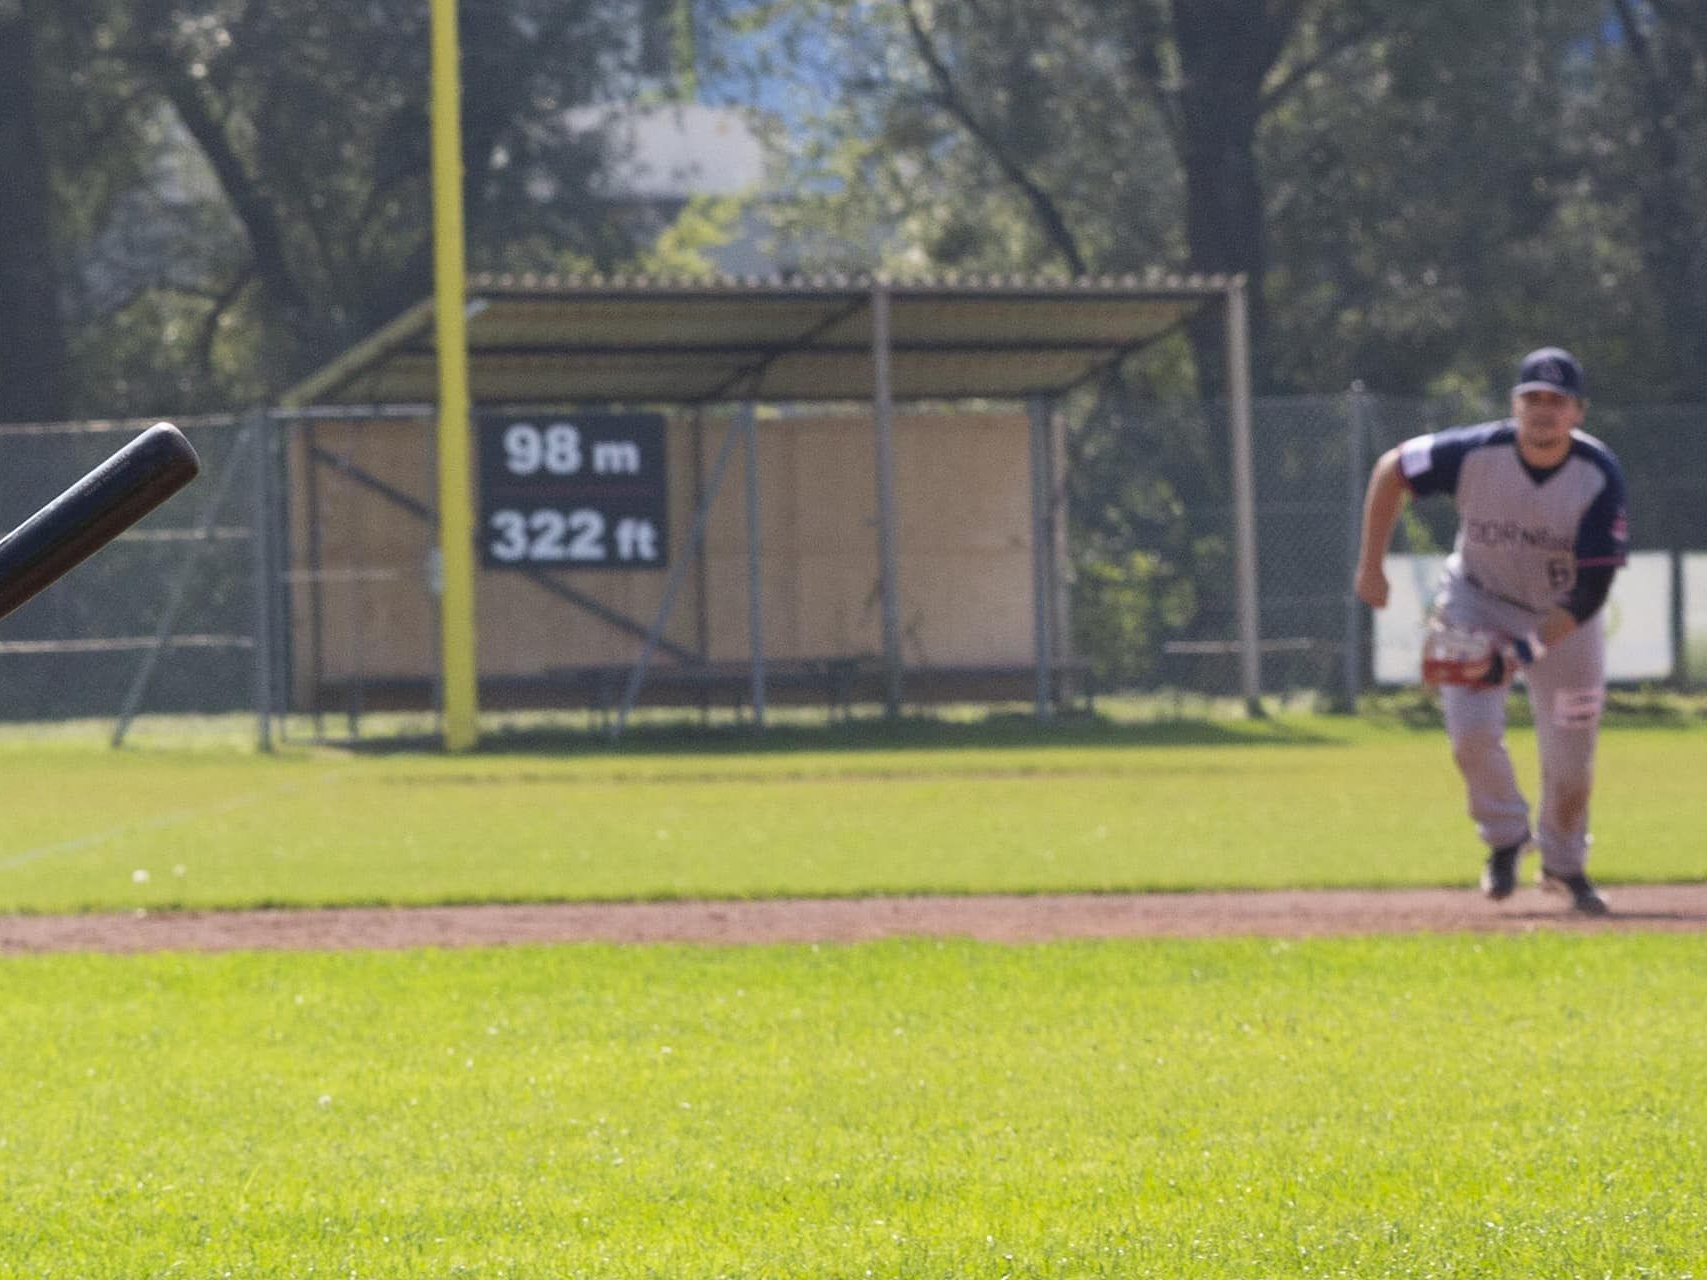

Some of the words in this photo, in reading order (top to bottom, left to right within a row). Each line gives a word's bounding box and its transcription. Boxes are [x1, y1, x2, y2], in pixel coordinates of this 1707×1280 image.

[502, 422, 583, 476] 98
[591, 440, 642, 476] m
[489, 507, 607, 561] 322
[615, 516, 659, 561] ft
